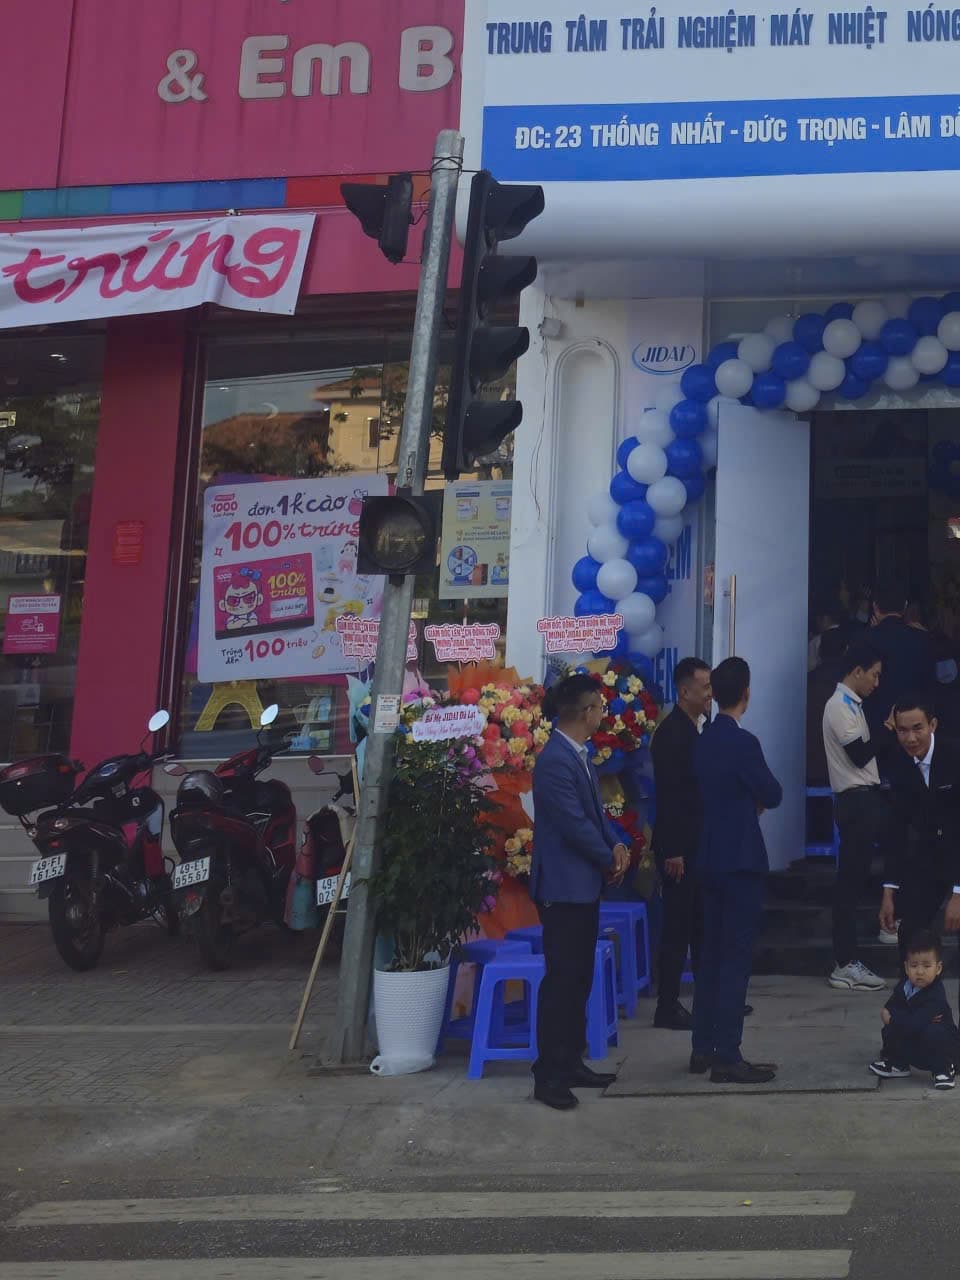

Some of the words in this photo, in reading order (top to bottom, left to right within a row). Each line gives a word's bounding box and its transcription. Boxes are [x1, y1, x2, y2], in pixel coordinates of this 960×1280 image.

[486, 21, 552, 55] TRUNG
[565, 14, 608, 53] TÂM
[620, 6, 665, 50] TRẢI
[677, 8, 756, 53] NGHIỆM
[770, 7, 814, 46] MÁY
[828, 5, 888, 49] NHIỆT
[157, 49, 209, 104] &
[238, 34, 371, 100] Em
[399, 25, 462, 93] B
[514, 126, 552, 150] ĐC:
[554, 125, 582, 148] 23
[590, 114, 660, 147] THỐNG
[670, 112, 725, 145] NHẤT
[743, 114, 788, 143] ĐỨC
[797, 116, 867, 147] TRỌNG
[884, 111, 931, 139] LÂM
[2, 225, 302, 304] trúng
[642, 346, 686, 363] JIDAI
[211, 501, 238, 513] 1000
[306, 495, 349, 514] cào
[223, 519, 296, 552] 100%
[267, 571, 306, 589] 100%
[244, 637, 285, 662] 100
